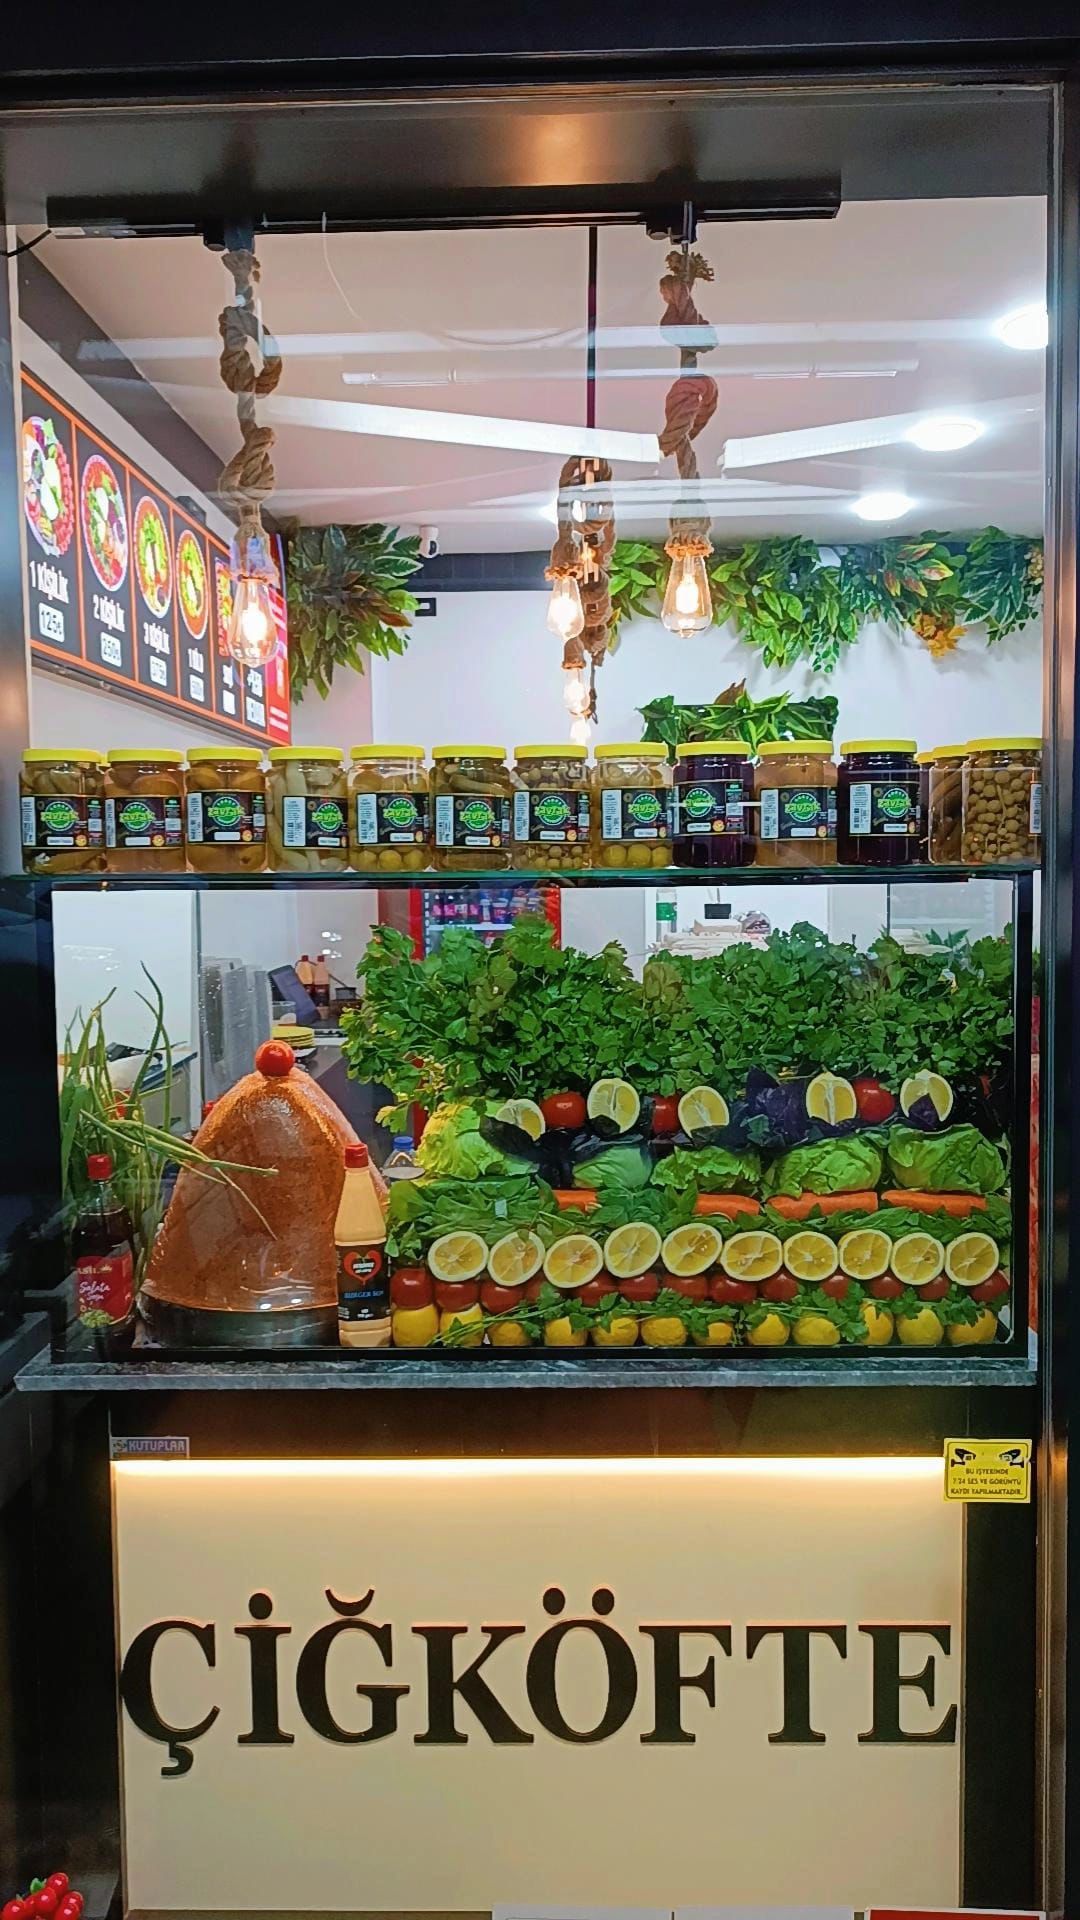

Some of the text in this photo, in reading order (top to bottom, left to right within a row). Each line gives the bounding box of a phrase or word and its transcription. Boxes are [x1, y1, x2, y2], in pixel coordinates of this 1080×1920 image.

[29, 560, 36, 588] 1
[93, 594, 100, 620] 2
[128, 1440, 185, 1451] KUTUPLAR
[120, 1587, 957, 1777] ÇİĞKÖFTE
